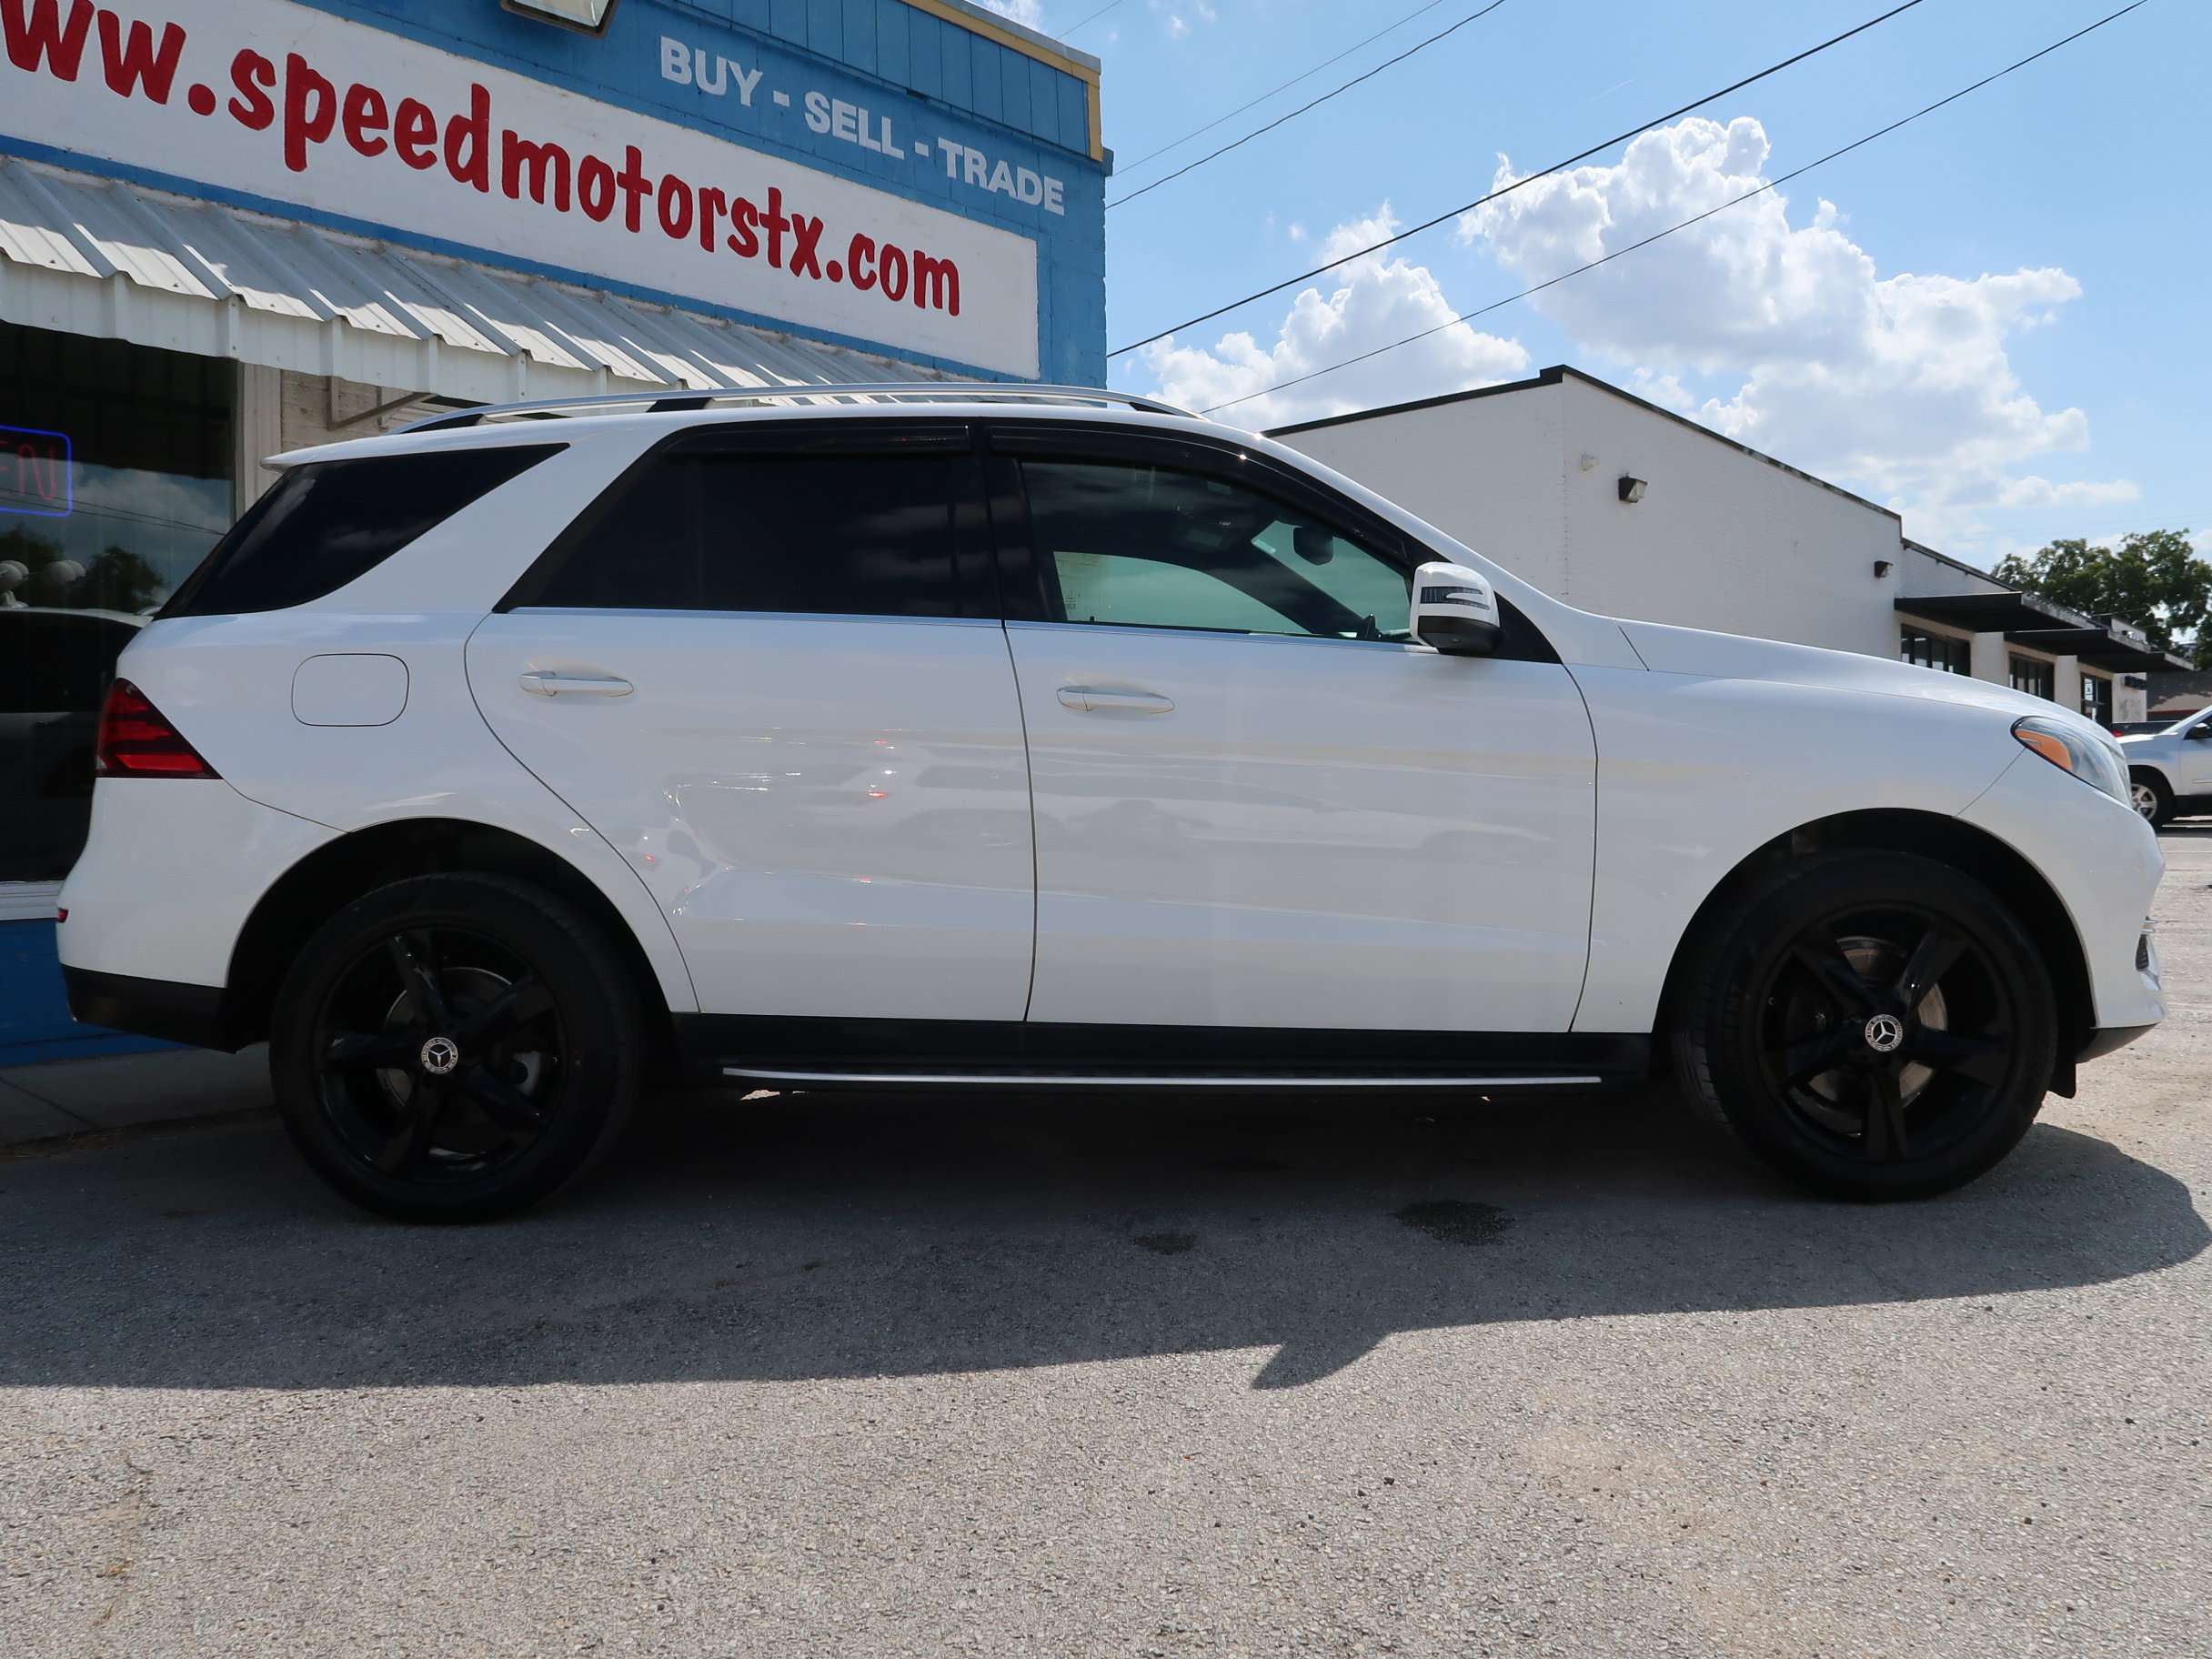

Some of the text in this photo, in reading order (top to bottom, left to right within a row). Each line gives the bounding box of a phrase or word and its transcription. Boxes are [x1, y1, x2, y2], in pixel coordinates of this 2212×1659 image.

[660, 35, 763, 107] BUY
[804, 91, 904, 160] SELL
[938, 138, 1065, 216] TRADE
